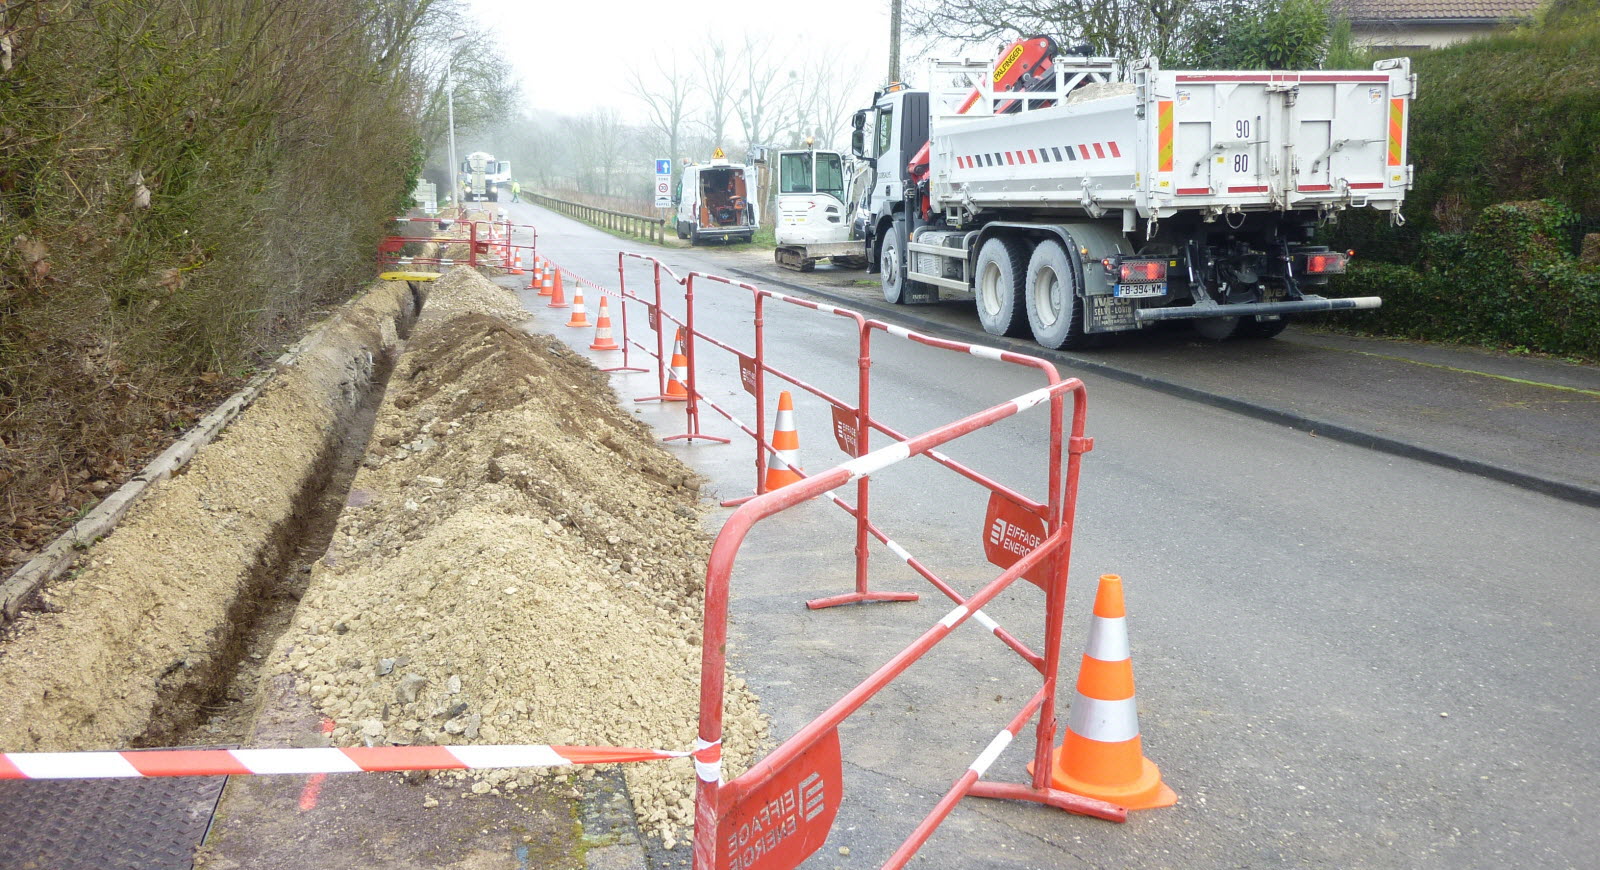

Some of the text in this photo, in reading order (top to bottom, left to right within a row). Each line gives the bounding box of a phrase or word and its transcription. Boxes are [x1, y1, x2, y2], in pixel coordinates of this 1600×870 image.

[993, 47, 1022, 81] PALFINGER
[1235, 119, 1250, 138] 90
[1233, 153, 1249, 173] 80
[1120, 284, 1161, 294] FB-394-WM
[1006, 523, 1041, 548] EIFFAGE
